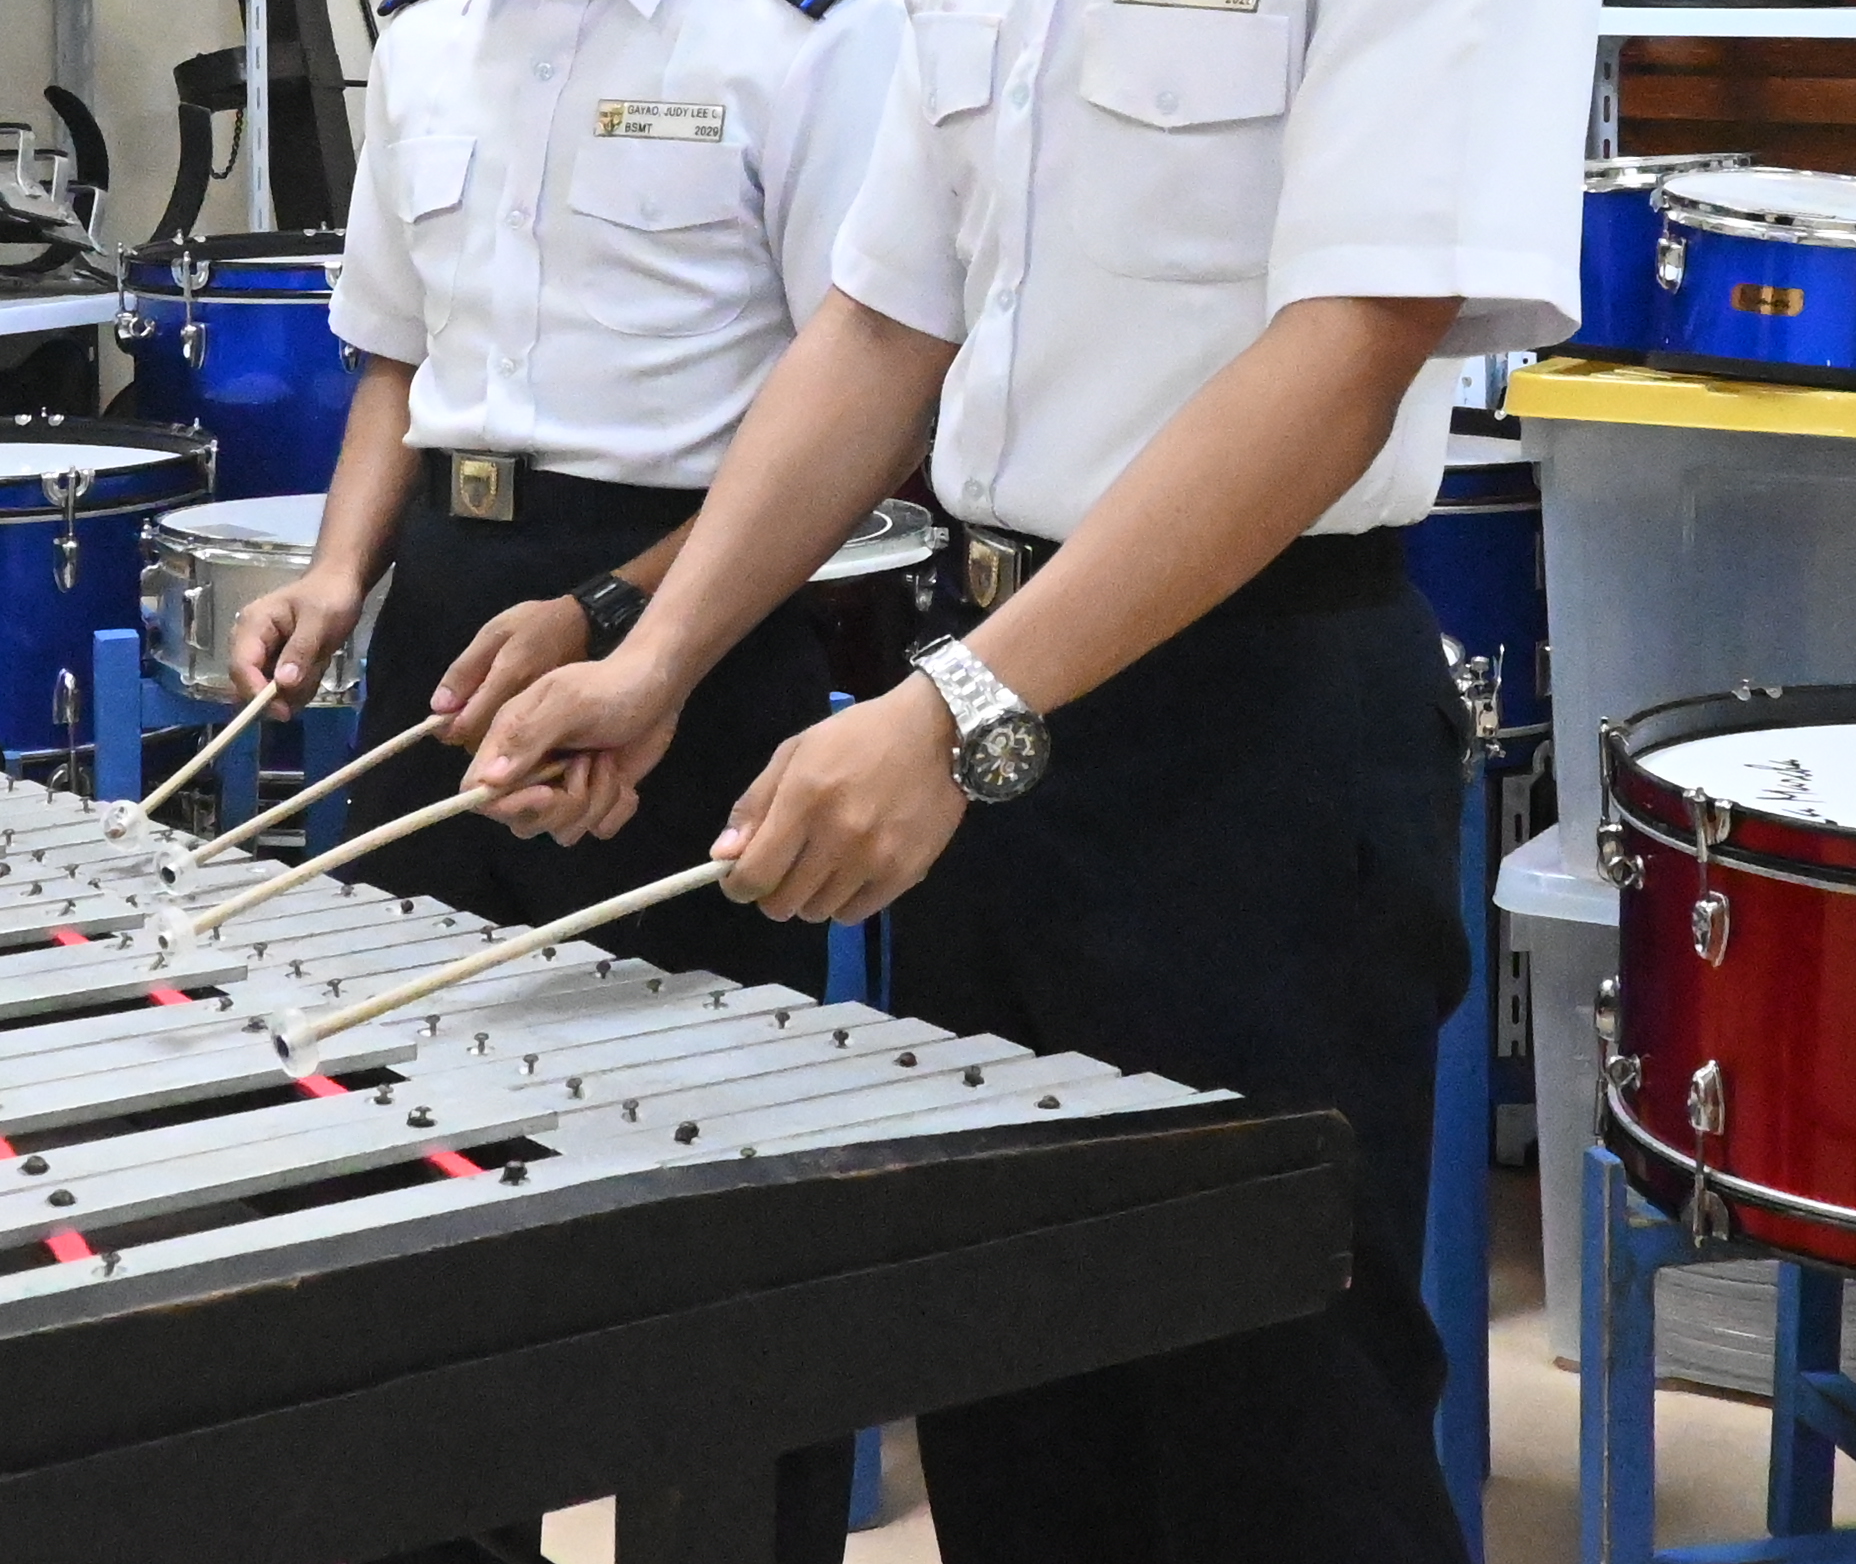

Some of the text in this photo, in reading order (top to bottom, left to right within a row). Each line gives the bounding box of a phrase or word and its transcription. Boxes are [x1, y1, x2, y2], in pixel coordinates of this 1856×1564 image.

[664, 107, 689, 117] JUDY
[691, 108, 708, 118] LEE
[625, 122, 719, 136] BSMT 2029
